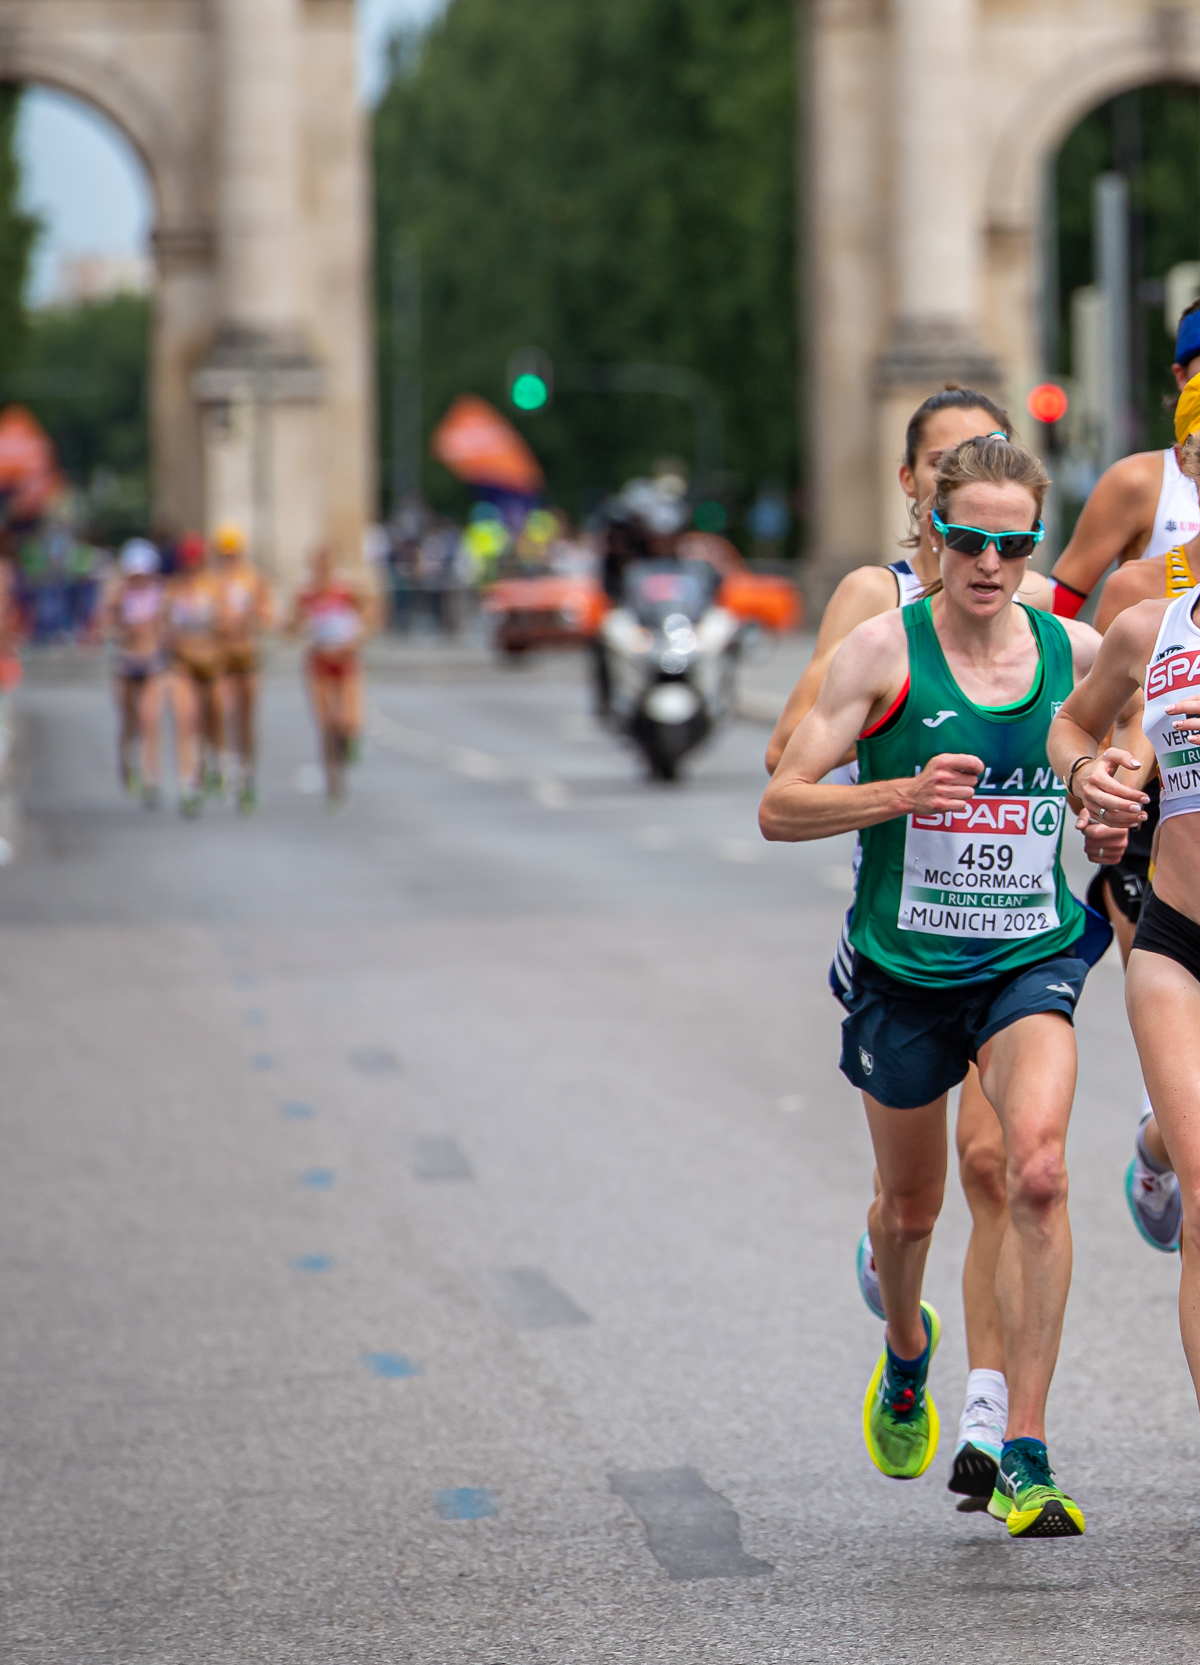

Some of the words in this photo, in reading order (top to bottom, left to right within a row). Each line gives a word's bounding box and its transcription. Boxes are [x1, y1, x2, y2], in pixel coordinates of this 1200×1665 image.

[915, 803, 1027, 831] SPAR
[958, 843, 1013, 871] 459
[924, 869, 1042, 889] MCCORMACK
[940, 892, 945, 903] I
[948, 892, 978, 906] RUN
[910, 907, 996, 931] MUNICH
[1003, 912, 1050, 931] 2022
